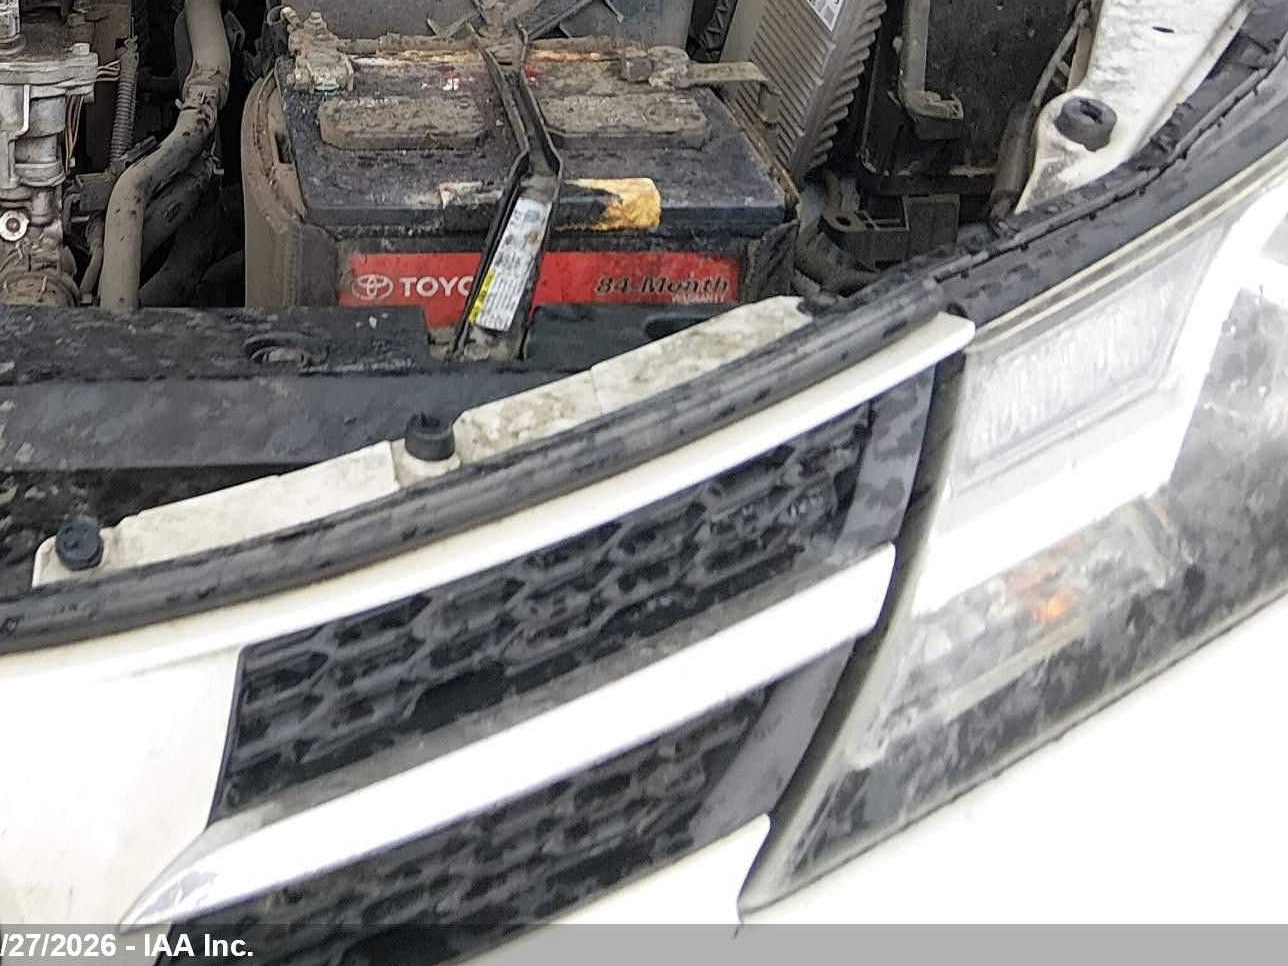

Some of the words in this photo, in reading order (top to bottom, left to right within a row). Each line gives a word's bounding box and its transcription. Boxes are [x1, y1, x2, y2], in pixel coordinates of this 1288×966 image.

[399, 275, 474, 297] TOYO
[595, 275, 630, 294] 84
[640, 273, 729, 294] Month
